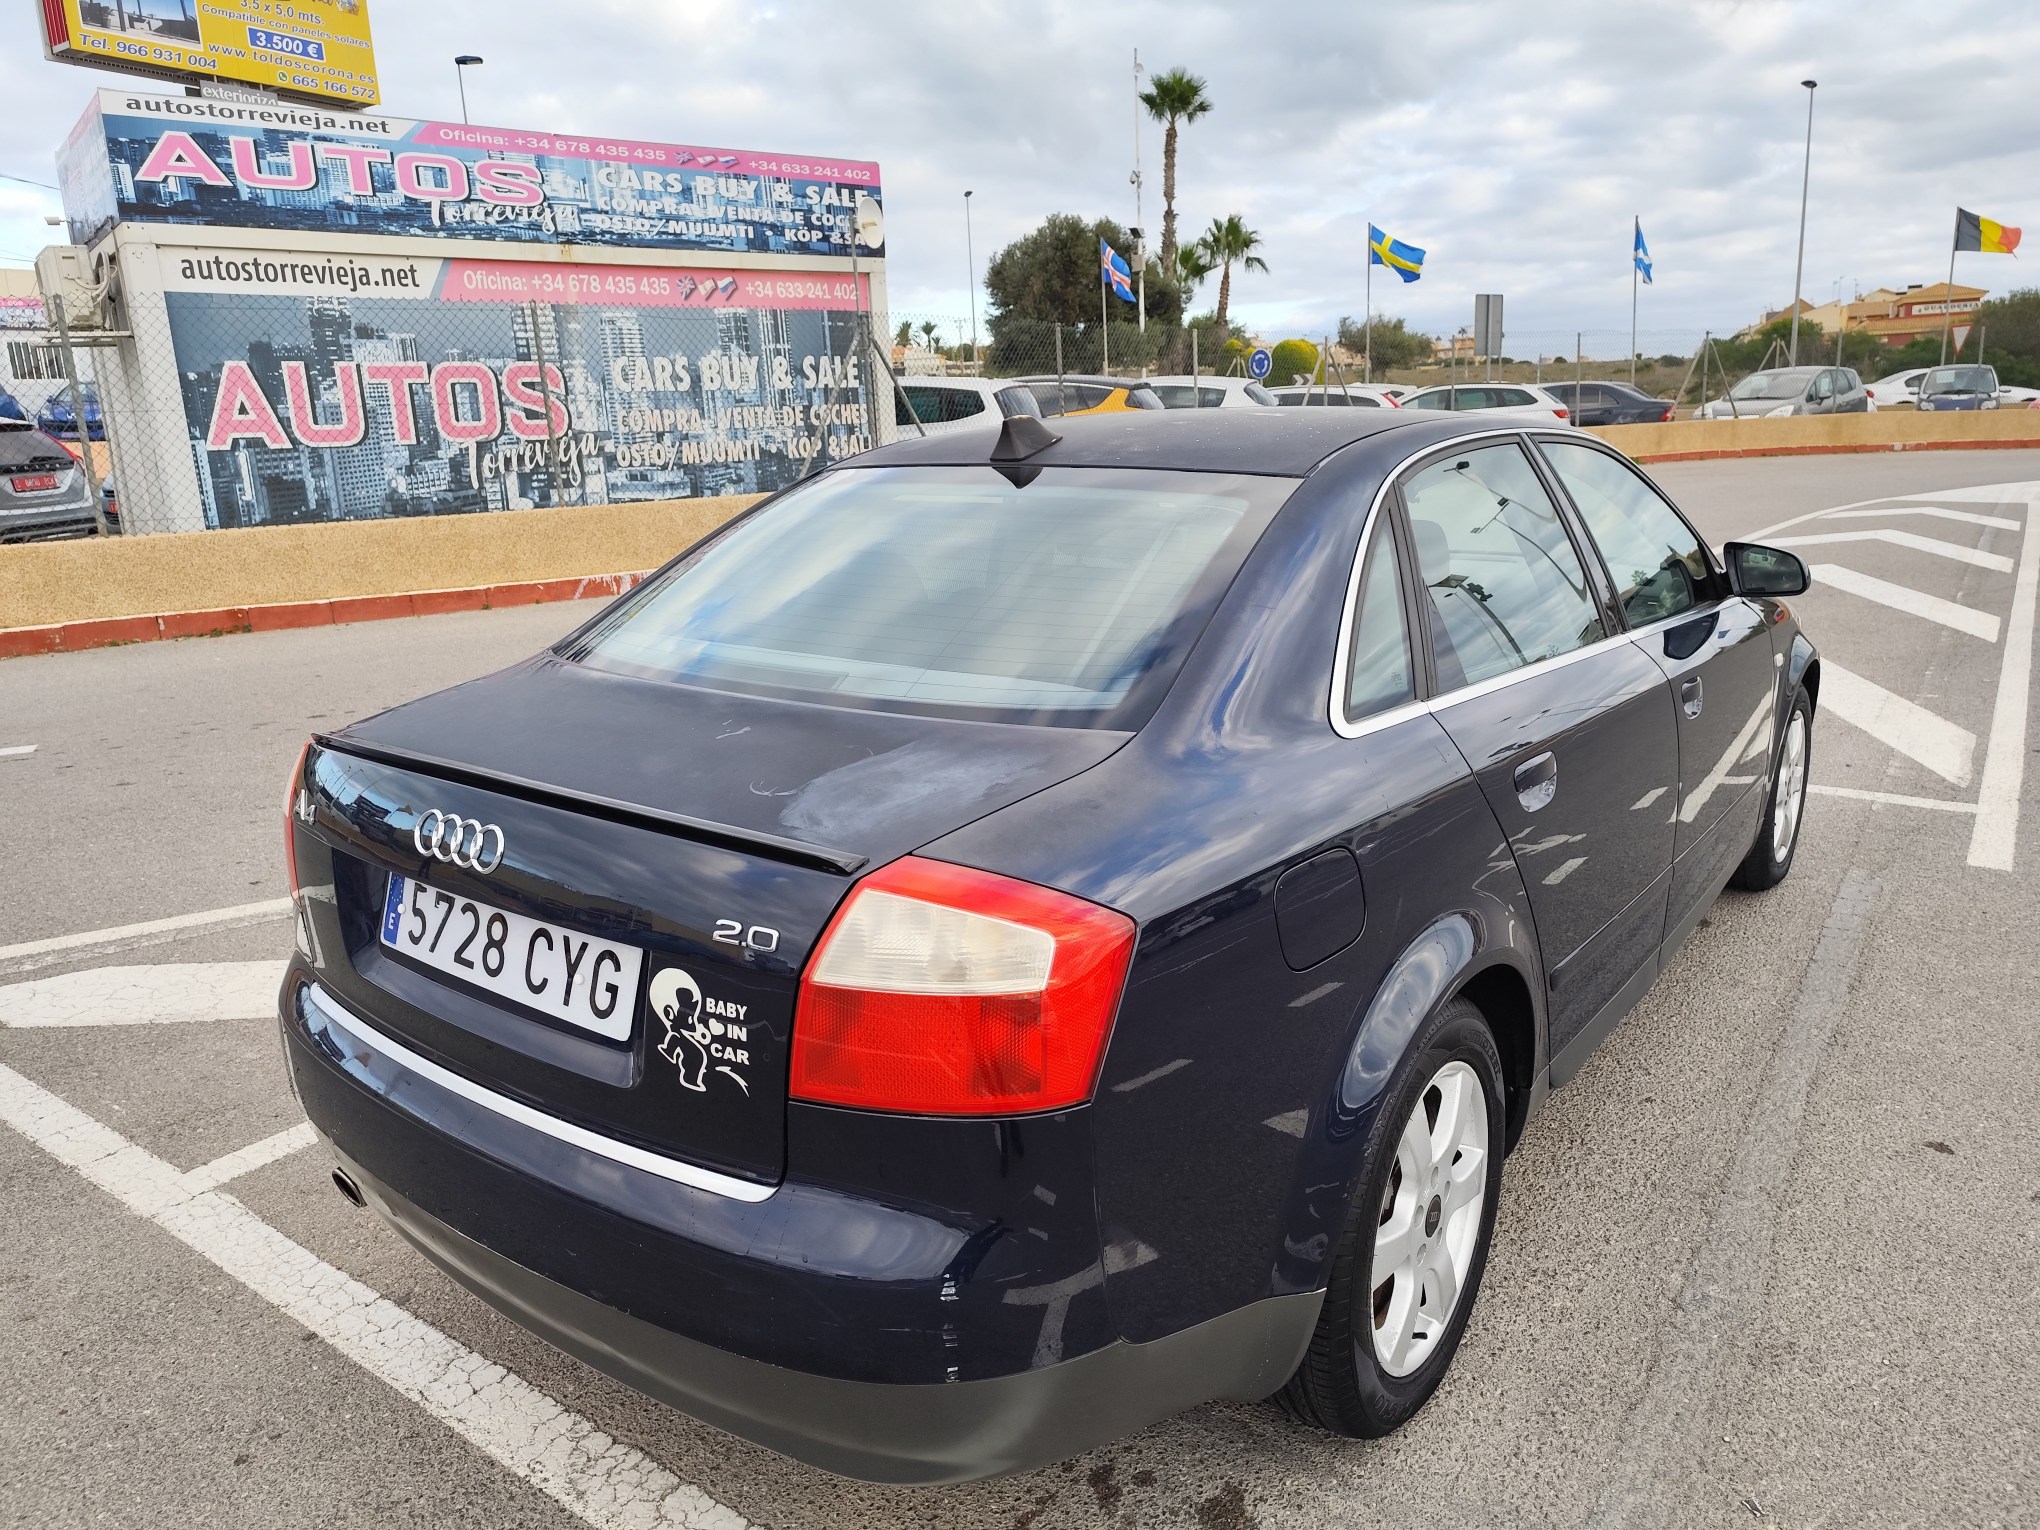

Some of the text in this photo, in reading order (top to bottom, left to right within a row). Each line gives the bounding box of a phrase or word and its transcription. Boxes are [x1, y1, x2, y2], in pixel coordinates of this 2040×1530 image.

[202, 3, 370, 49] Compatible con paneles solares
[264, 4, 271, 12] x
[275, 4, 294, 18] 5,0
[298, 11, 325, 25] mts.
[79, 33, 218, 70] Tel. 966 931 004
[256, 32, 319, 58] 3.500 €
[208, 43, 375, 84] www.toldoscorona.es
[292, 74, 376, 99] 665 166 572
[126, 98, 391, 134] autostorrevieja.net
[439, 128, 666, 161] Oficina: +34 678 435 435
[134, 130, 546, 207] AUTOS
[598, 167, 683, 193] CARS
[696, 175, 759, 200] BUY
[772, 182, 795, 203] &
[748, 160, 871, 180] +34 633 241 402
[421, 198, 578, 234] Torrevieja
[598, 197, 693, 216] COMPRA
[711, 205, 774, 223] VENTA
[781, 211, 805, 224] DE
[784, 226, 823, 242] KÖP
[181, 255, 420, 292] autostorrevieja.net
[463, 269, 670, 295] Oficina: +34 678 435 435
[745, 280, 859, 300] +34 633 241 402
[612, 355, 691, 392] CARS
[700, 355, 760, 391] BUY
[772, 355, 794, 390] &
[206, 360, 569, 450] AUTOS
[617, 403, 868, 432] COMPRA VENTA DE COCHES
[462, 430, 600, 489] Torreveja
[788, 431, 822, 459] KÖP
[295, 789, 317, 825] A4
[408, 882, 509, 978] 5728
[525, 927, 621, 1020] CYG
[712, 918, 780, 952] 2.0
[706, 997, 748, 1020] BABY
[727, 1023, 747, 1042] IN
[710, 1043, 750, 1065] CAR
